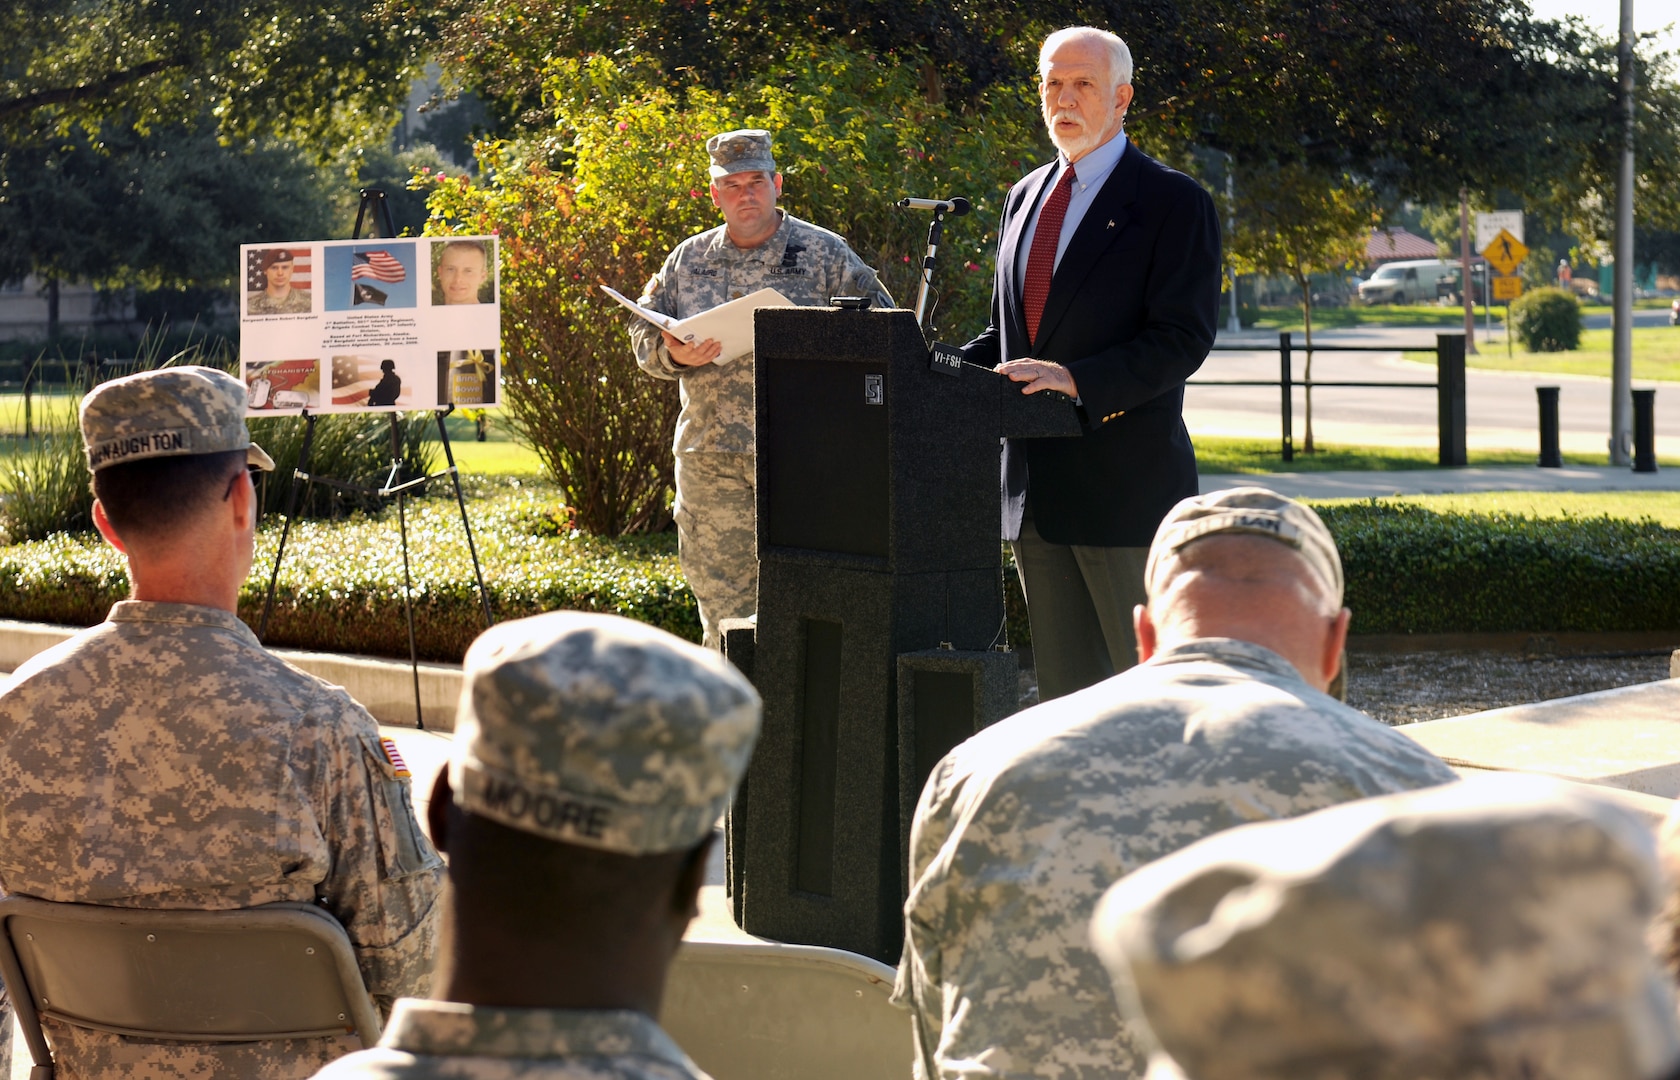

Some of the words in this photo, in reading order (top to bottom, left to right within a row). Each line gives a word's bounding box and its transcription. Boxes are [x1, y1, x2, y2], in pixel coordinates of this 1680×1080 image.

[456, 375, 480, 383] Bring
[455, 385, 481, 393] Bowe
[483, 776, 612, 841] MOORE
